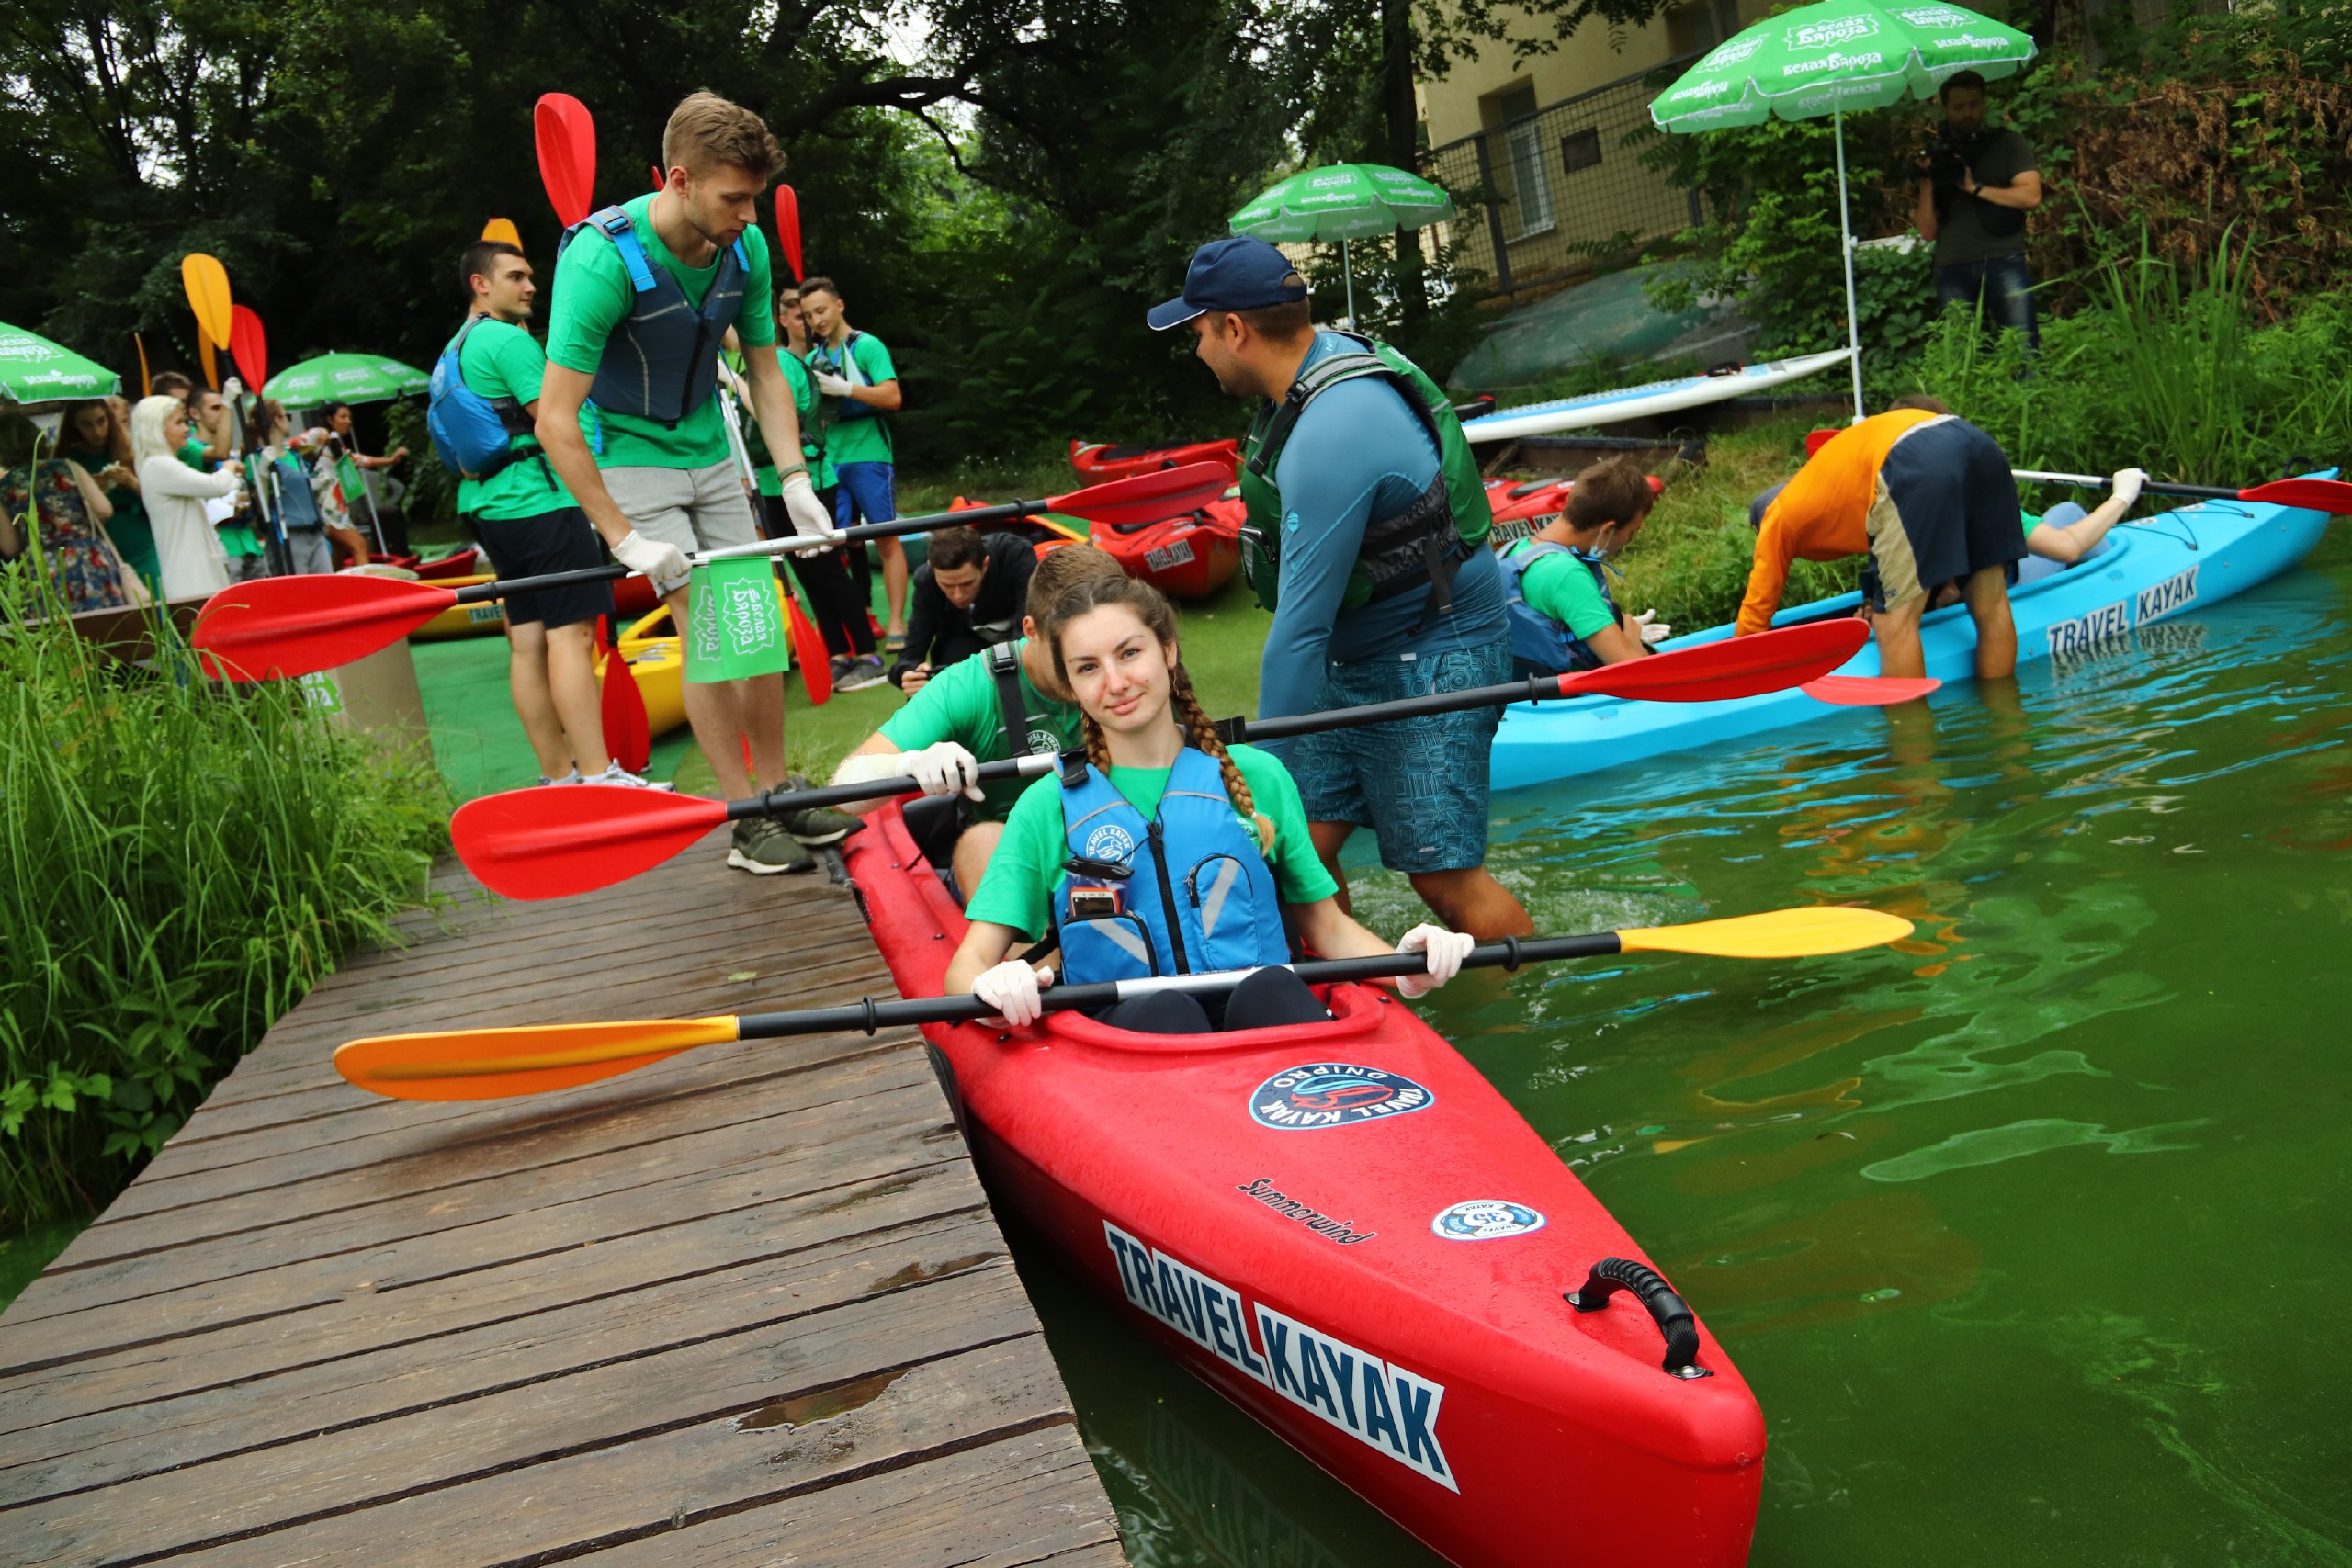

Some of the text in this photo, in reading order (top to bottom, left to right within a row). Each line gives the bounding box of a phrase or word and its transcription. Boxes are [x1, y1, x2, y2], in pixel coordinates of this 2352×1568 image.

[1492, 519, 1536, 542] RAVEL
[469, 606, 503, 623] TRAVE
[2049, 568, 2197, 655] TRAVEL KAYAK
[1089, 828, 1130, 856] TRAVEL KAYAK
[1273, 1066, 1389, 1088] DNIPRO
[1259, 1088, 1424, 1125] TRAVEL KAYAK
[1236, 1178, 1376, 1245] Summerwind
[1472, 1212, 1507, 1226] 35
[1108, 1231, 1447, 1478] TRAVEL KAYAK
